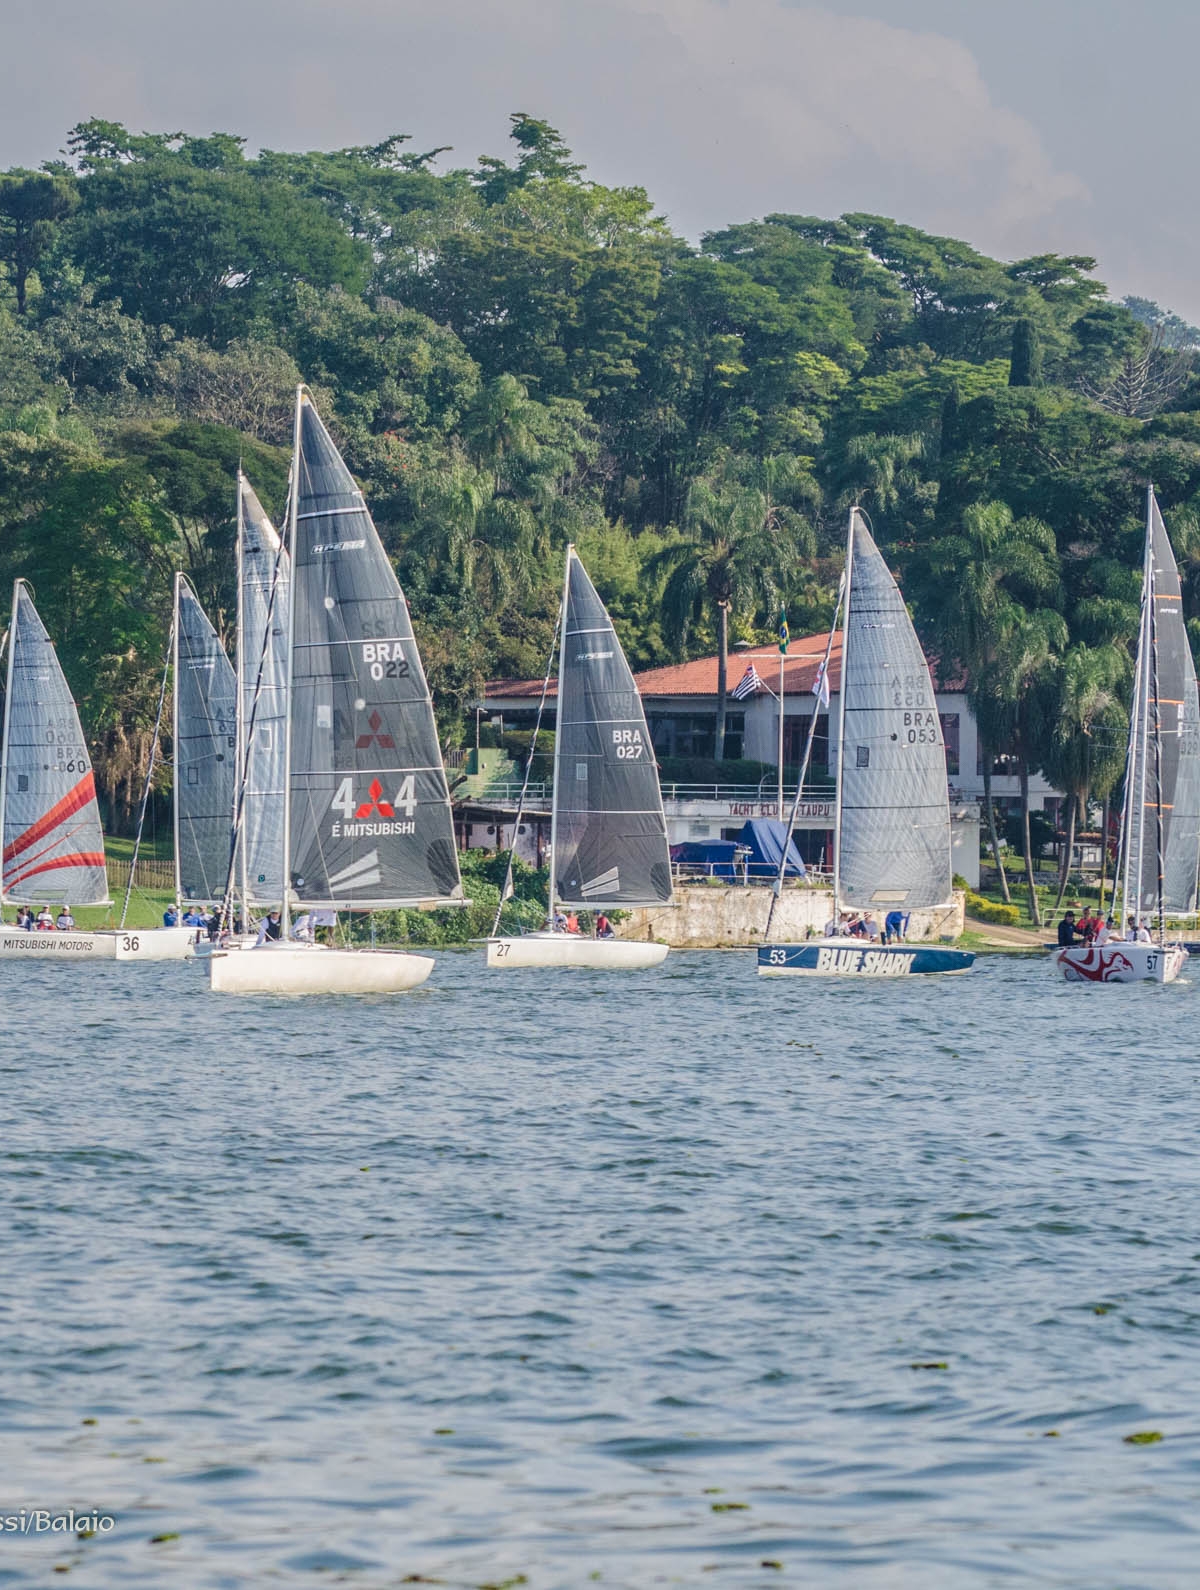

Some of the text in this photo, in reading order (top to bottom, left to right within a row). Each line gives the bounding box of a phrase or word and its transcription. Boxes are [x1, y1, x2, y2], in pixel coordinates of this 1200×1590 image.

[362, 642, 406, 663] BRA
[370, 661, 410, 681] 022
[904, 712, 935, 726] BRA
[613, 729, 642, 743] BRA
[908, 729, 937, 743] 053
[57, 747, 84, 759] BRA
[616, 745, 643, 759] 027
[59, 760, 87, 773] 060
[331, 775, 418, 819] 4 4
[728, 803, 758, 817] YACHT
[760, 803, 784, 817] CLU
[332, 821, 415, 837] É MITSUBISHI
[3, 939, 94, 951] MITSUBISHI MOTORS
[122, 936, 140, 951] 36
[497, 944, 511, 957] 27
[769, 950, 786, 964] 53
[817, 948, 917, 974] BLUE SHARK
[1147, 955, 1158, 970] 57
